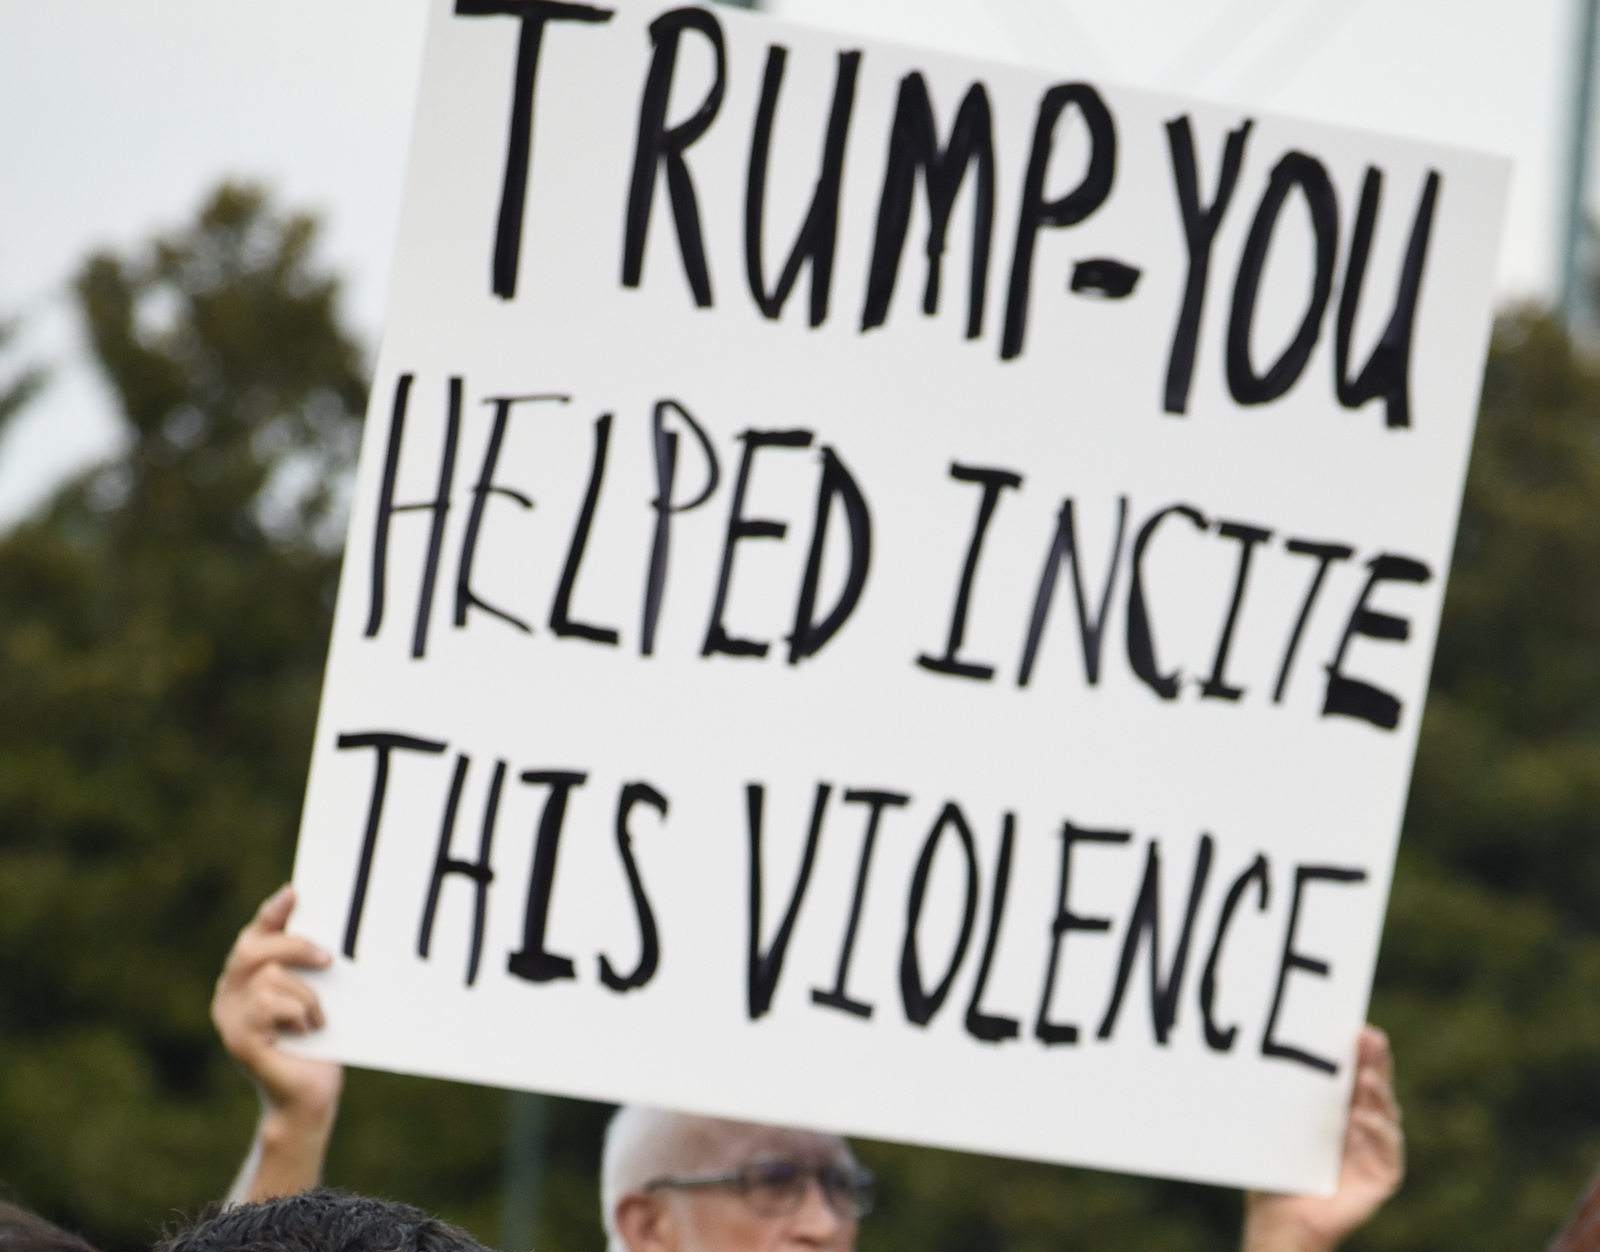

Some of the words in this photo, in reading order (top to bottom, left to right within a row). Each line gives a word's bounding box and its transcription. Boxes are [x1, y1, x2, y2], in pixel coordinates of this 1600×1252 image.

[364, 373, 873, 666] HELPED
[915, 462, 1432, 732] INCITE
[335, 731, 669, 994] THIS
[745, 782, 1367, 1076] VIOLENCE
